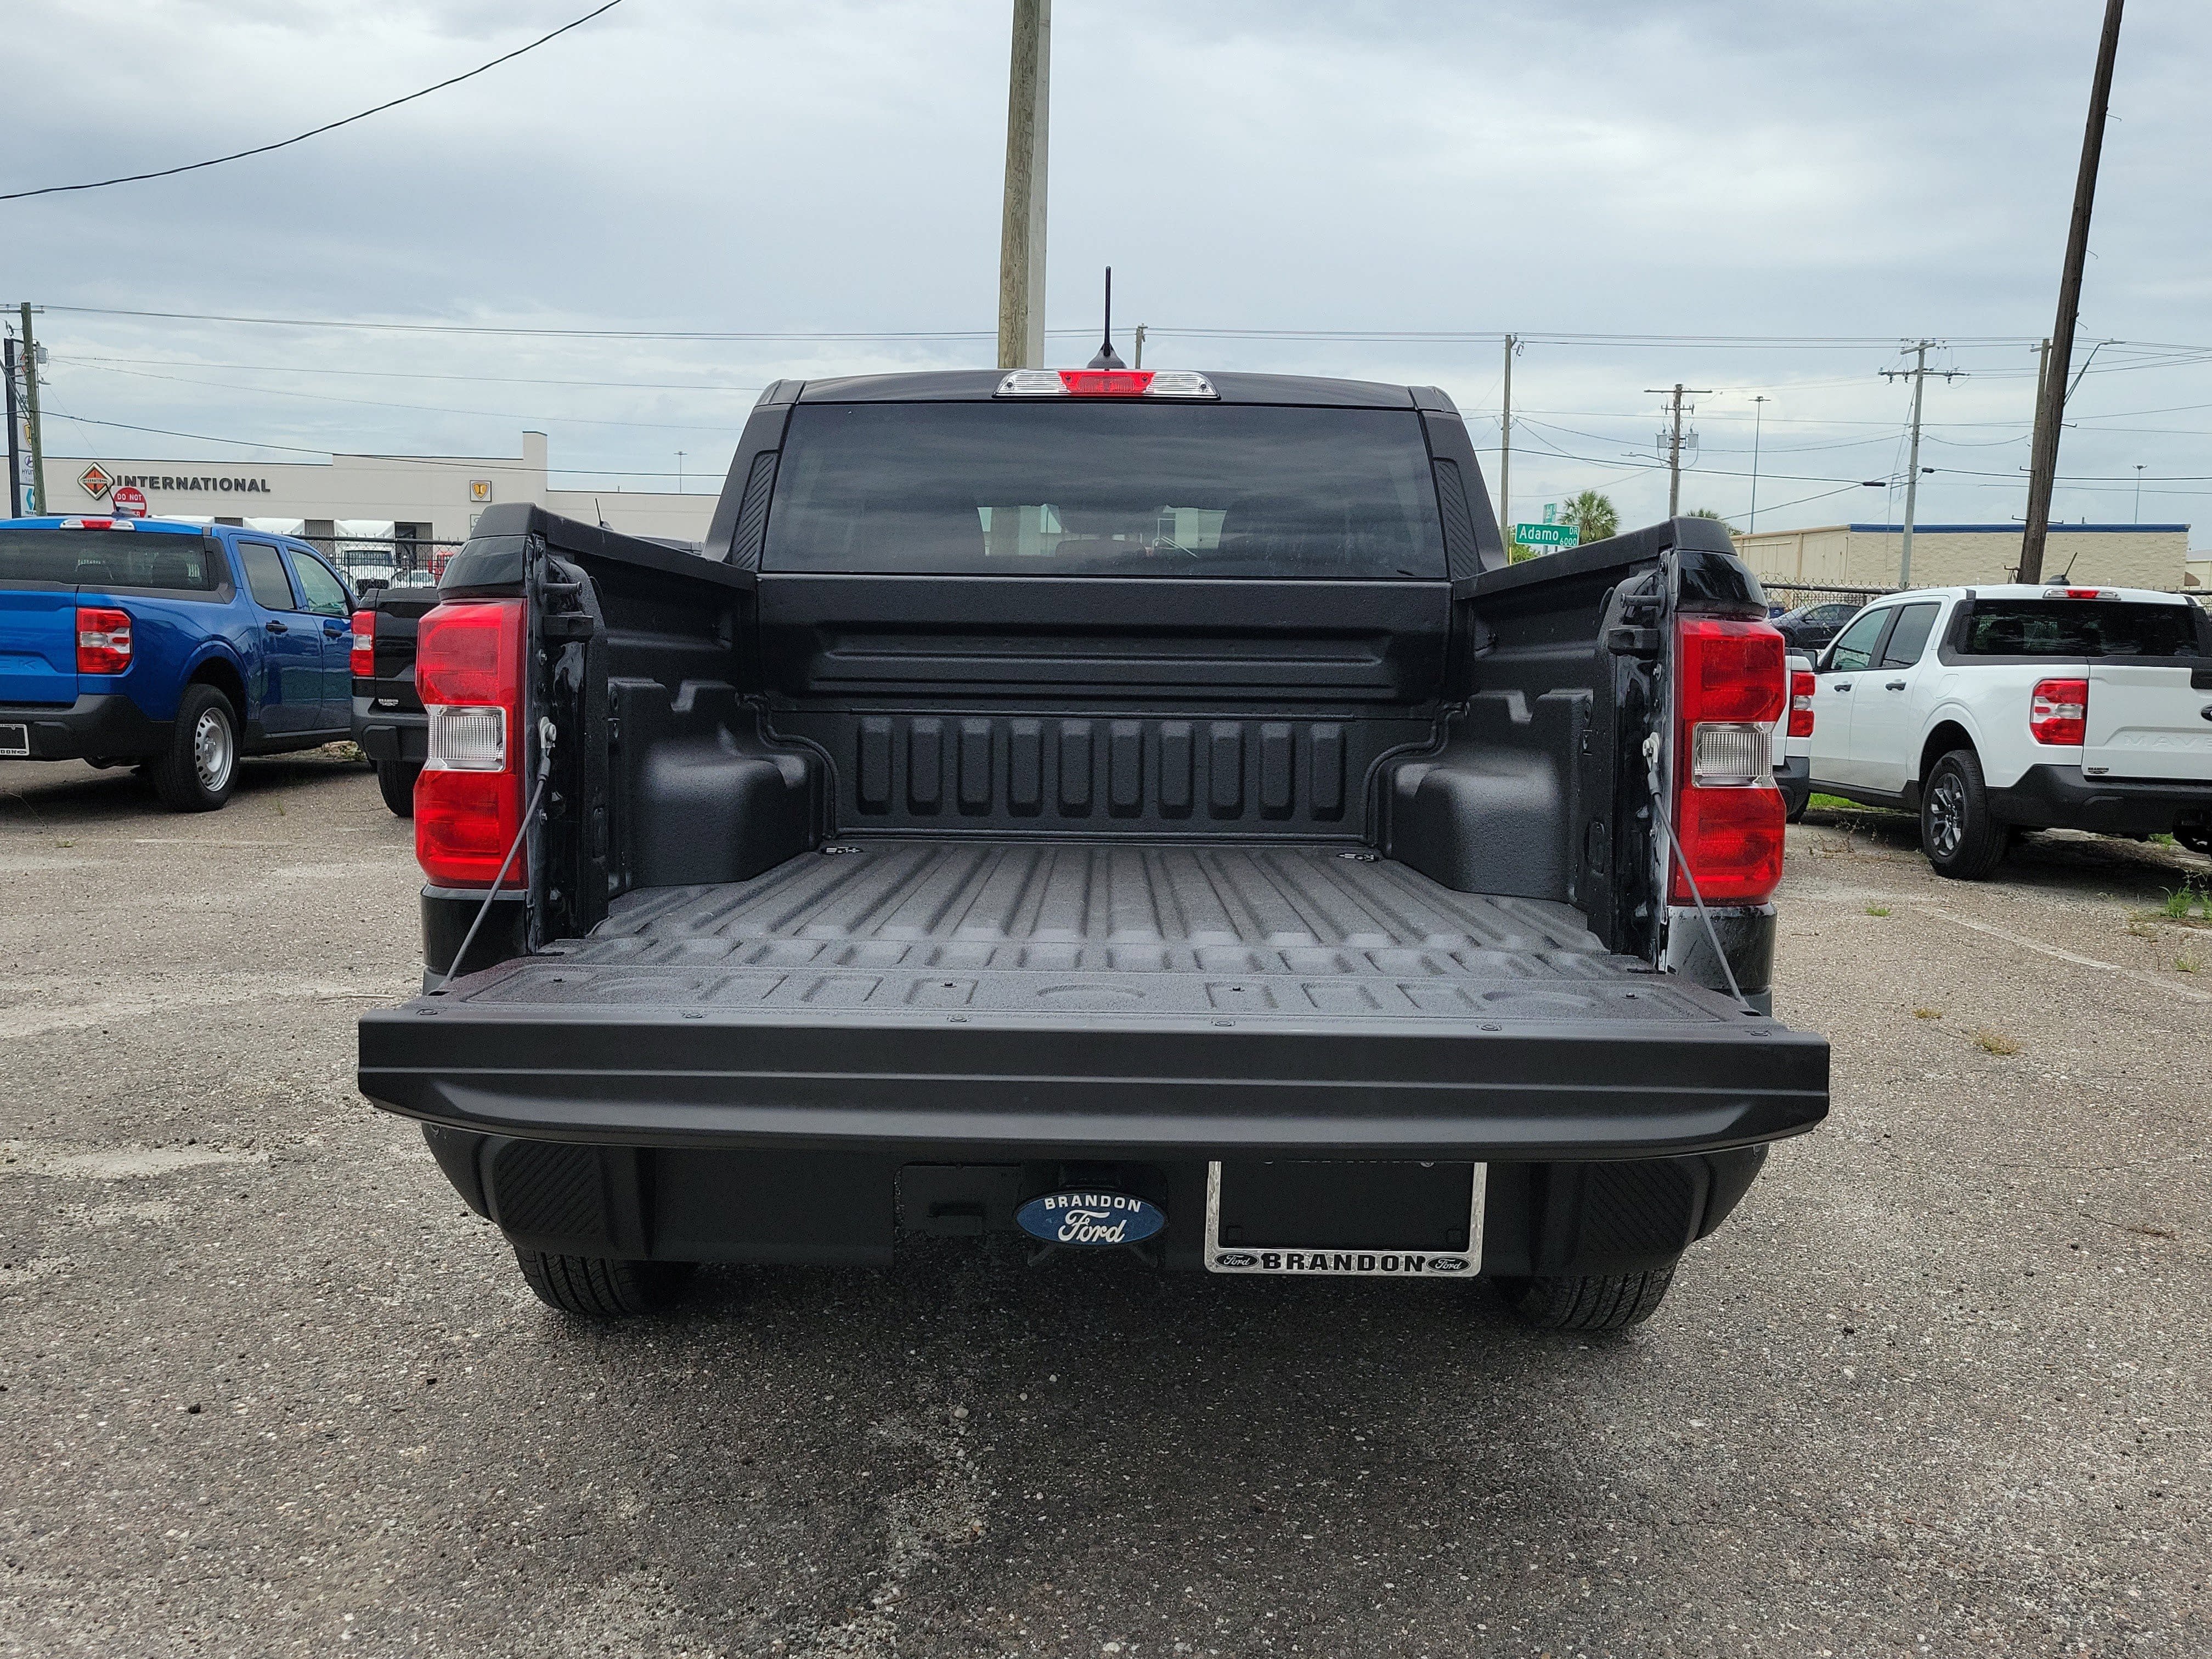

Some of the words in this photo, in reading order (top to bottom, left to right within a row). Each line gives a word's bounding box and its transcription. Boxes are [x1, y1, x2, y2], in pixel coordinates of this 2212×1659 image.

[117, 475, 270, 493] INTERNATIONAL
[1519, 526, 1559, 541] Adamo
[1569, 527, 1578, 535] DR
[1045, 1195, 1141, 1212] BRANDON
[1058, 1210, 1127, 1243] Ford
[1223, 1254, 1251, 1267] Ford
[1261, 1253, 1425, 1272] BRANDON
[1434, 1258, 1462, 1270] Ford
